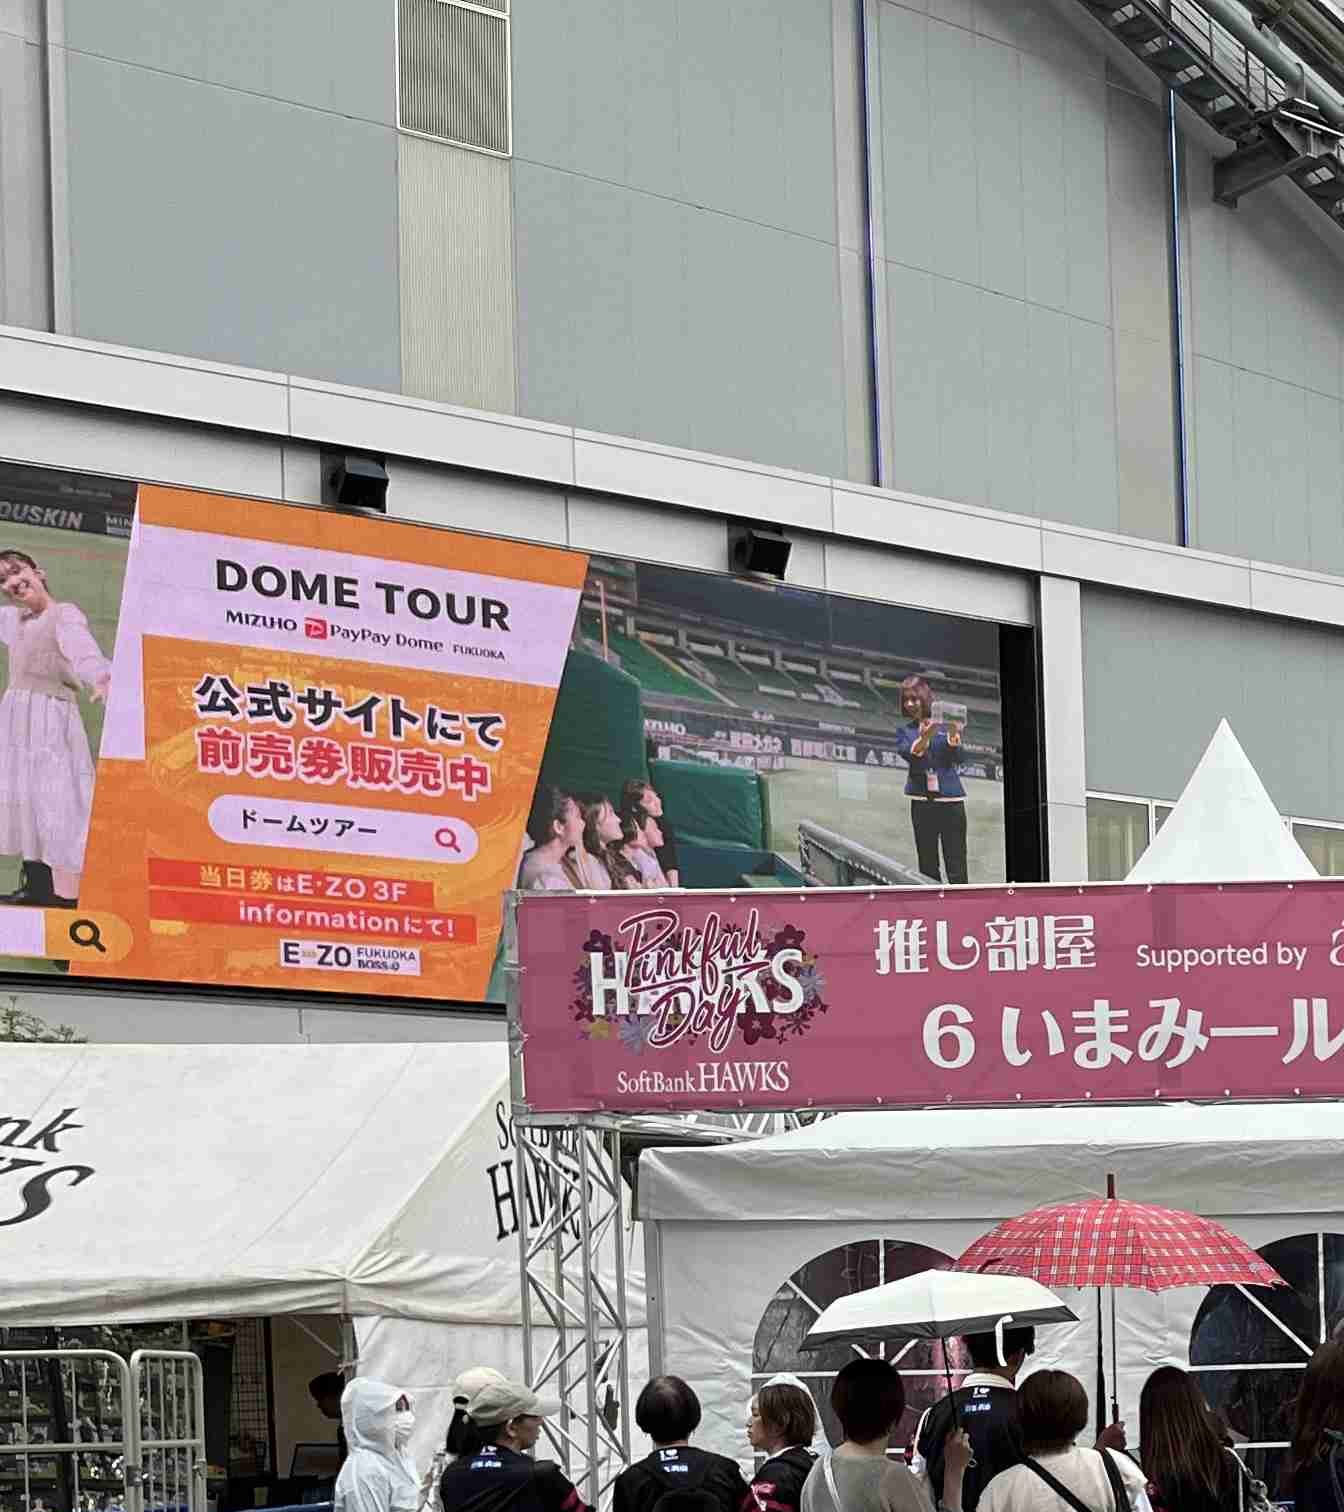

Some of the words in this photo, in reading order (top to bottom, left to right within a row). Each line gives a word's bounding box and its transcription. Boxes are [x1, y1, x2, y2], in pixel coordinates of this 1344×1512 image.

[215, 559, 360, 609] DOME
[375, 581, 511, 632] TOUR
[226, 609, 298, 632] MIZUHO
[330, 624, 392, 647] PayPay
[396, 633, 444, 652] Dome
[452, 644, 506, 660] FUKUOKA
[195, 675, 503, 747] 公式サイトにて
[196, 728, 490, 797] 前売券販売中
[241, 808, 377, 837] ドームツアー
[373, 880, 408, 901] 3F
[875, 914, 1097, 975] 推し部屋
[1136, 942, 1270, 972] Supported
[1276, 941, 1307, 970] by
[617, 1068, 696, 1094] SoftBank
[697, 1061, 790, 1093] HAWKS
